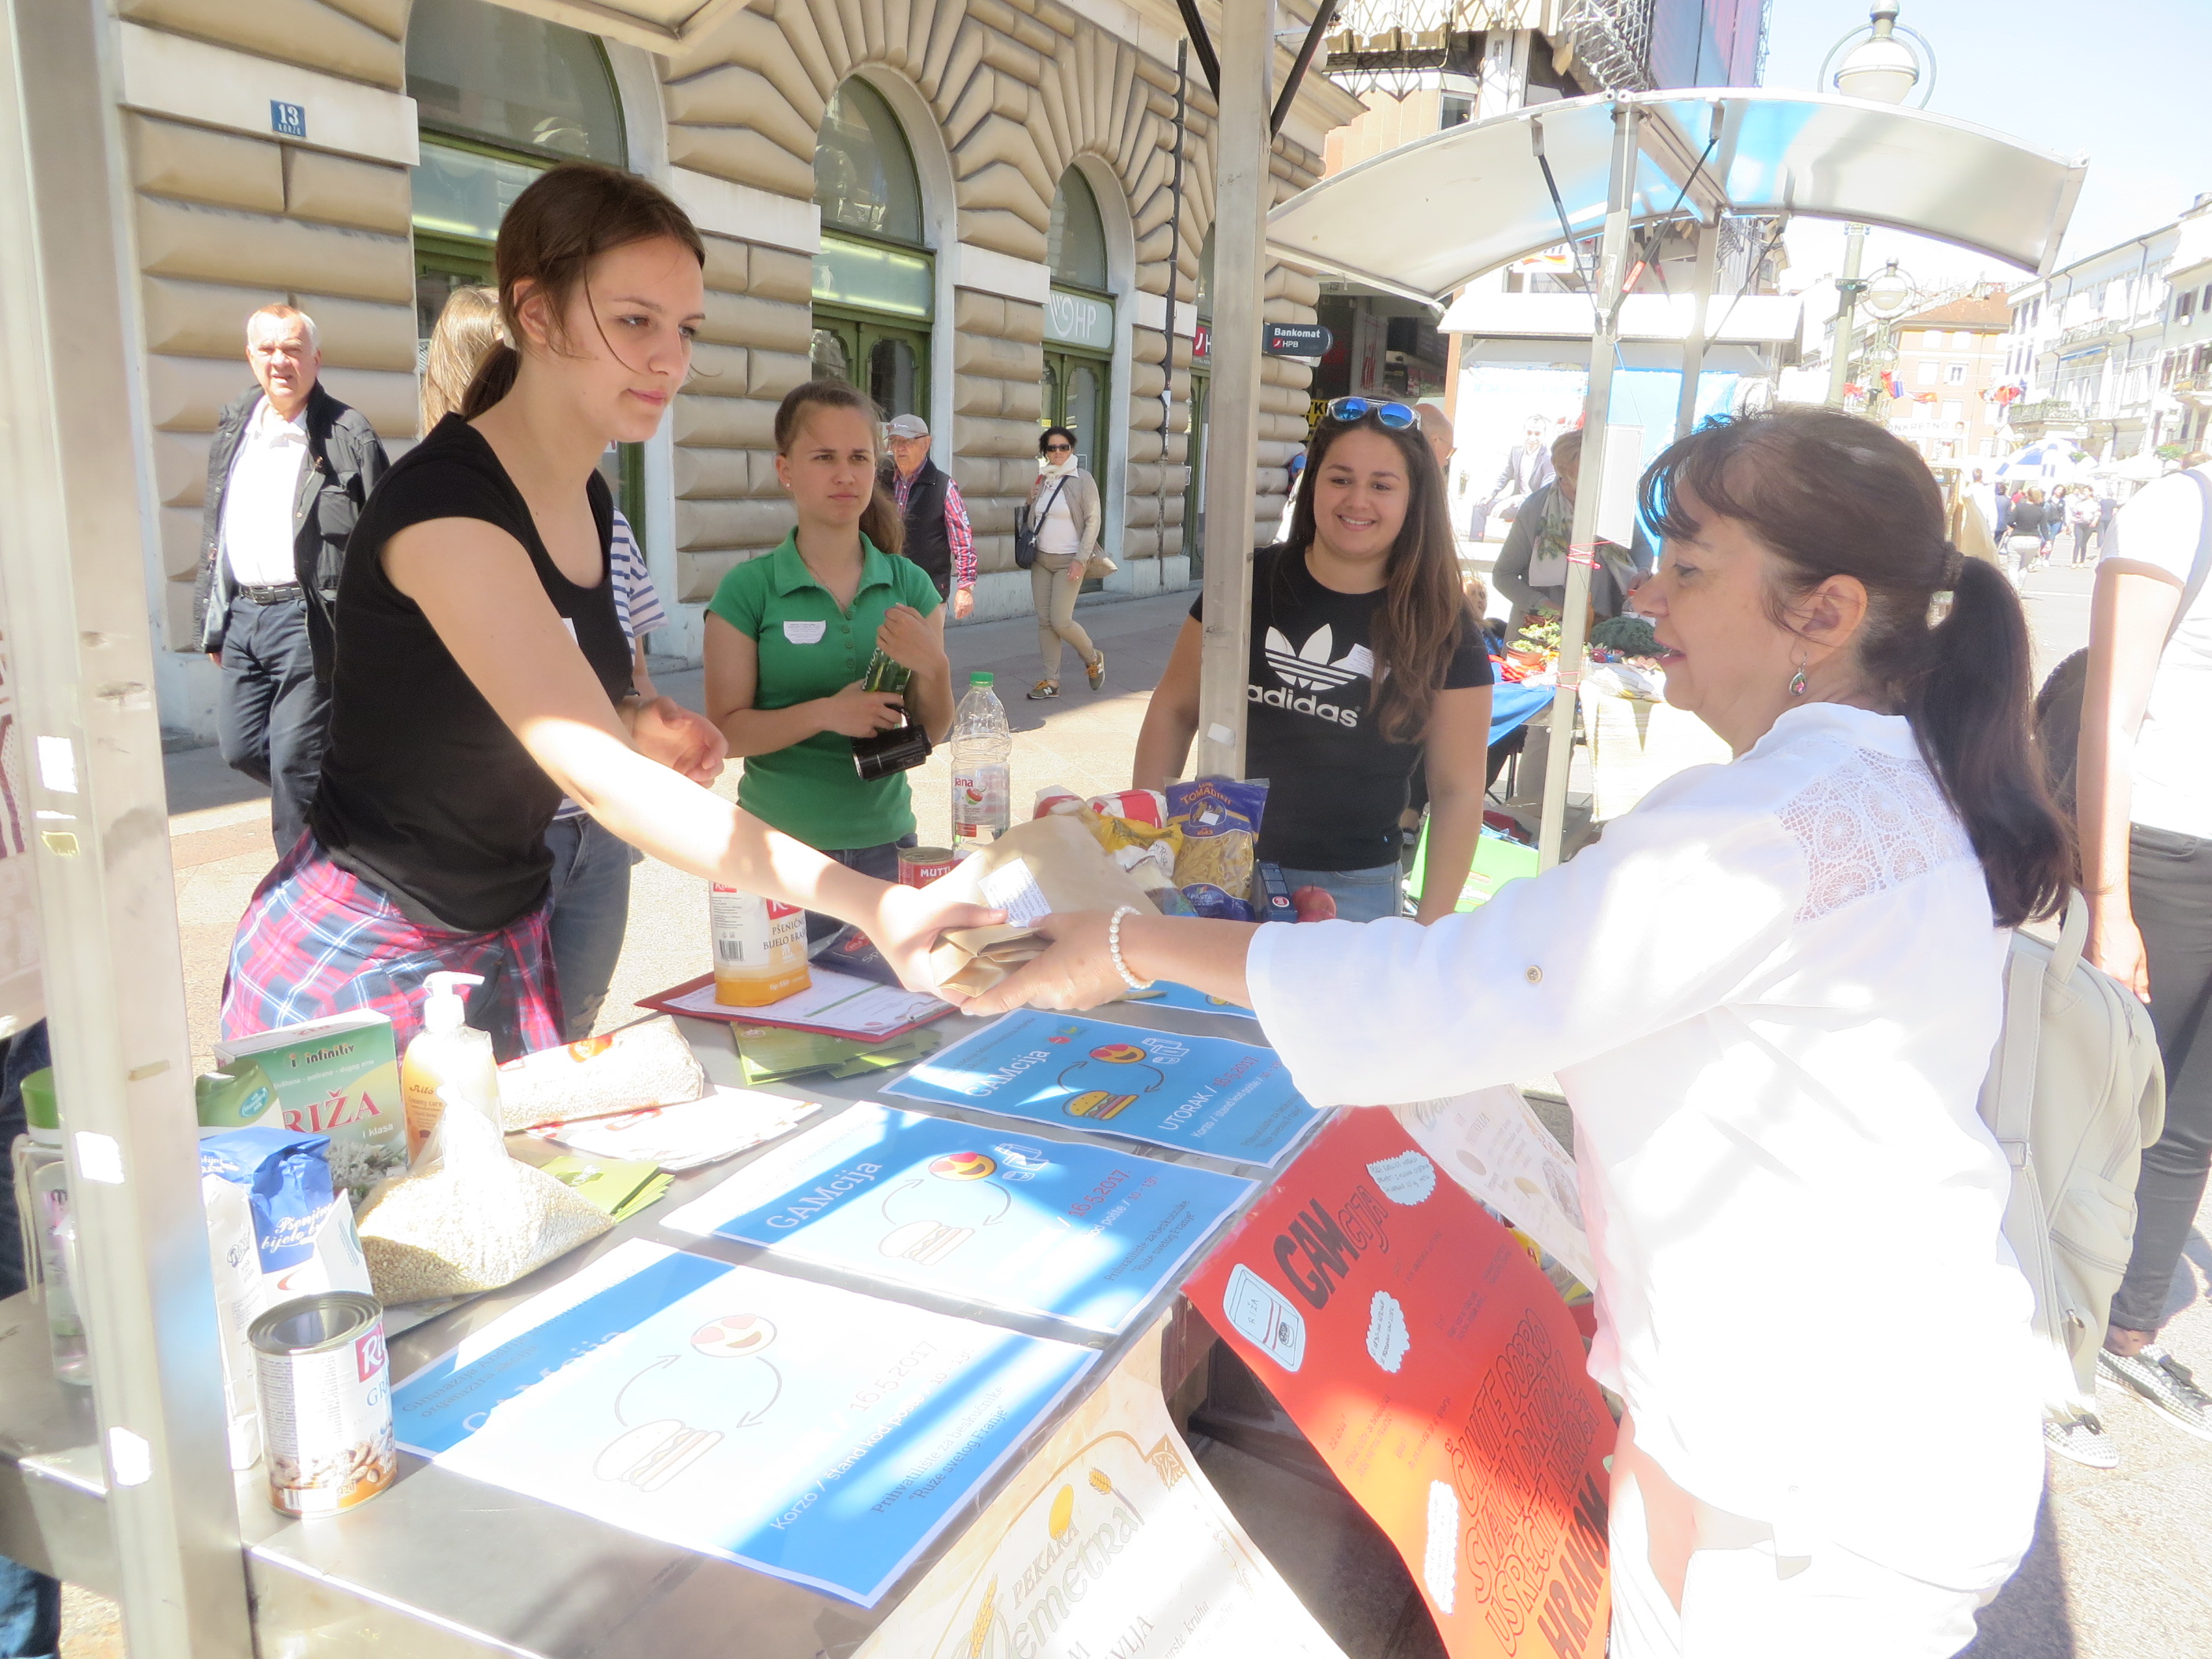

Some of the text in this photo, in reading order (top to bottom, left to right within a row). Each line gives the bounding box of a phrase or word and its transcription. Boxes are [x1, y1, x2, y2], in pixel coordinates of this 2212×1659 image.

[279, 104, 299, 126] 13
[1076, 302, 1097, 339] HP
[1274, 328, 1321, 339] Bankomat
[1247, 683, 1358, 727] adidas
[1180, 787, 1232, 806] TOMADINI
[763, 935, 789, 950] BIJELO
[305, 1043, 355, 1064] infinitiv
[965, 1049, 1052, 1097] GAMcija
[282, 1087, 383, 1133] RIŽA
[368, 1123, 394, 1138] klasa
[1156, 1092, 1214, 1130] UTORAK
[1190, 1121, 1215, 1137] Korzo
[765, 1162, 884, 1229] GAMcija
[261, 1227, 306, 1254] bijelo
[1496, 1307, 1553, 1413] DOBRO
[401, 1368, 482, 1414] Gimnazija
[420, 1371, 496, 1419] organizira
[770, 1492, 819, 1531] Korzo
[825, 1442, 869, 1481] štand
[859, 1425, 893, 1448] kod
[930, 1373, 948, 1386] 10
[870, 1384, 1005, 1514] Prihvatilište za beskućnike
[943, 1438, 982, 1474] svetog
[1547, 1387, 1602, 1507] NEKOGA
[1466, 1446, 1538, 1605] SVAKIM
[1011, 1515, 1079, 1610] PEKARA
[1182, 1600, 1210, 1635] kruha
